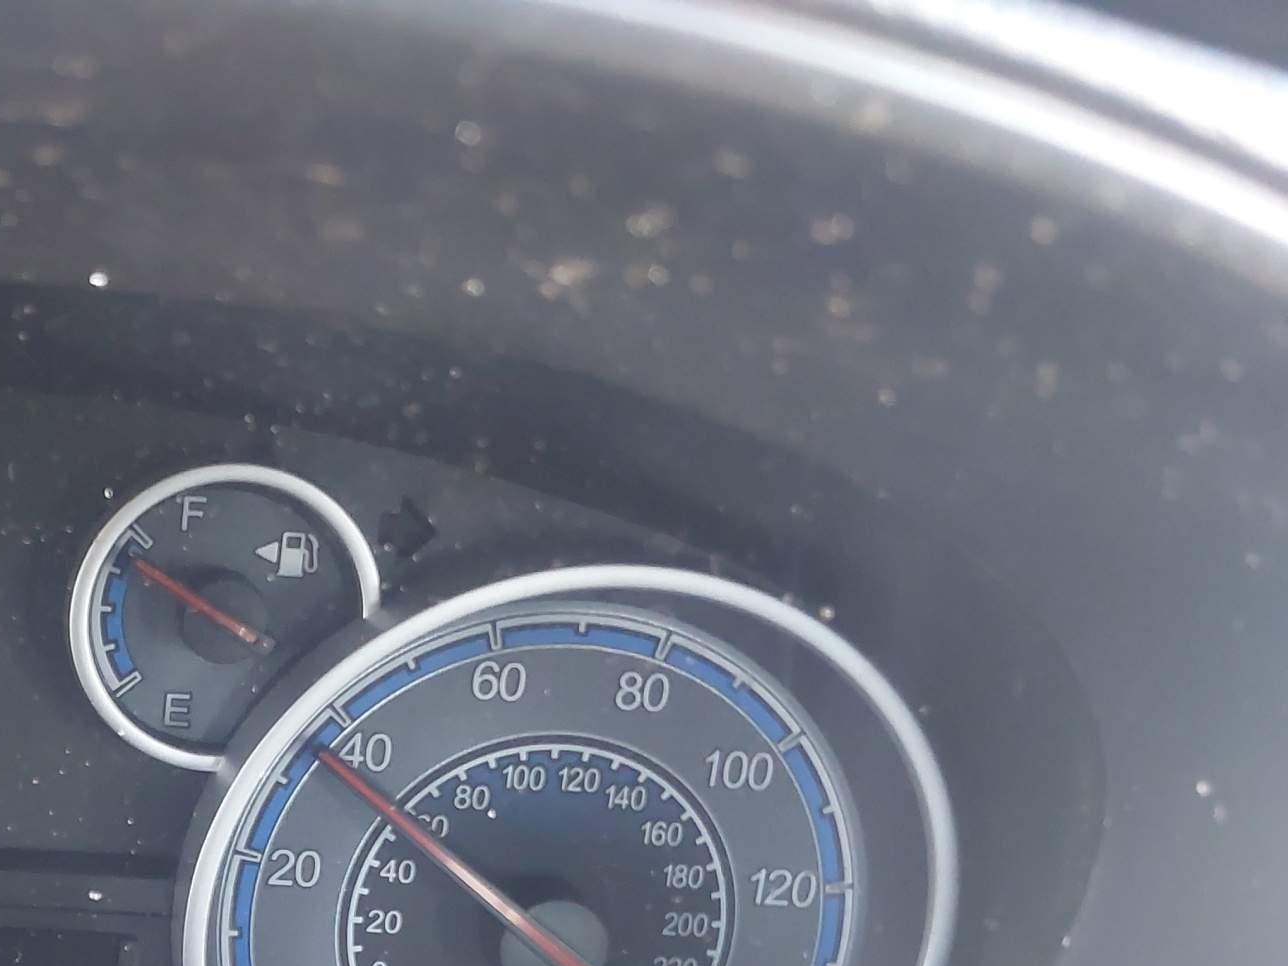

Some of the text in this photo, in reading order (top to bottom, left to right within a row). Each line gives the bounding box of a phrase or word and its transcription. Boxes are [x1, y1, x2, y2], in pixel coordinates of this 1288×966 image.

[181, 496, 207, 531] F
[472, 661, 526, 701] 60
[615, 671, 670, 712] 80
[164, 693, 191, 727] E
[338, 732, 392, 772] 40
[502, 765, 546, 792] 100
[559, 766, 600, 793] 120
[705, 750, 774, 791] 100
[453, 785, 490, 811] 80
[605, 784, 646, 811] 140
[641, 821, 683, 846] 160
[267, 849, 321, 888] 20
[379, 860, 416, 884] 40
[664, 864, 704, 889] 180
[750, 869, 816, 908] 120
[365, 910, 403, 934] 20
[662, 913, 708, 937] 200
